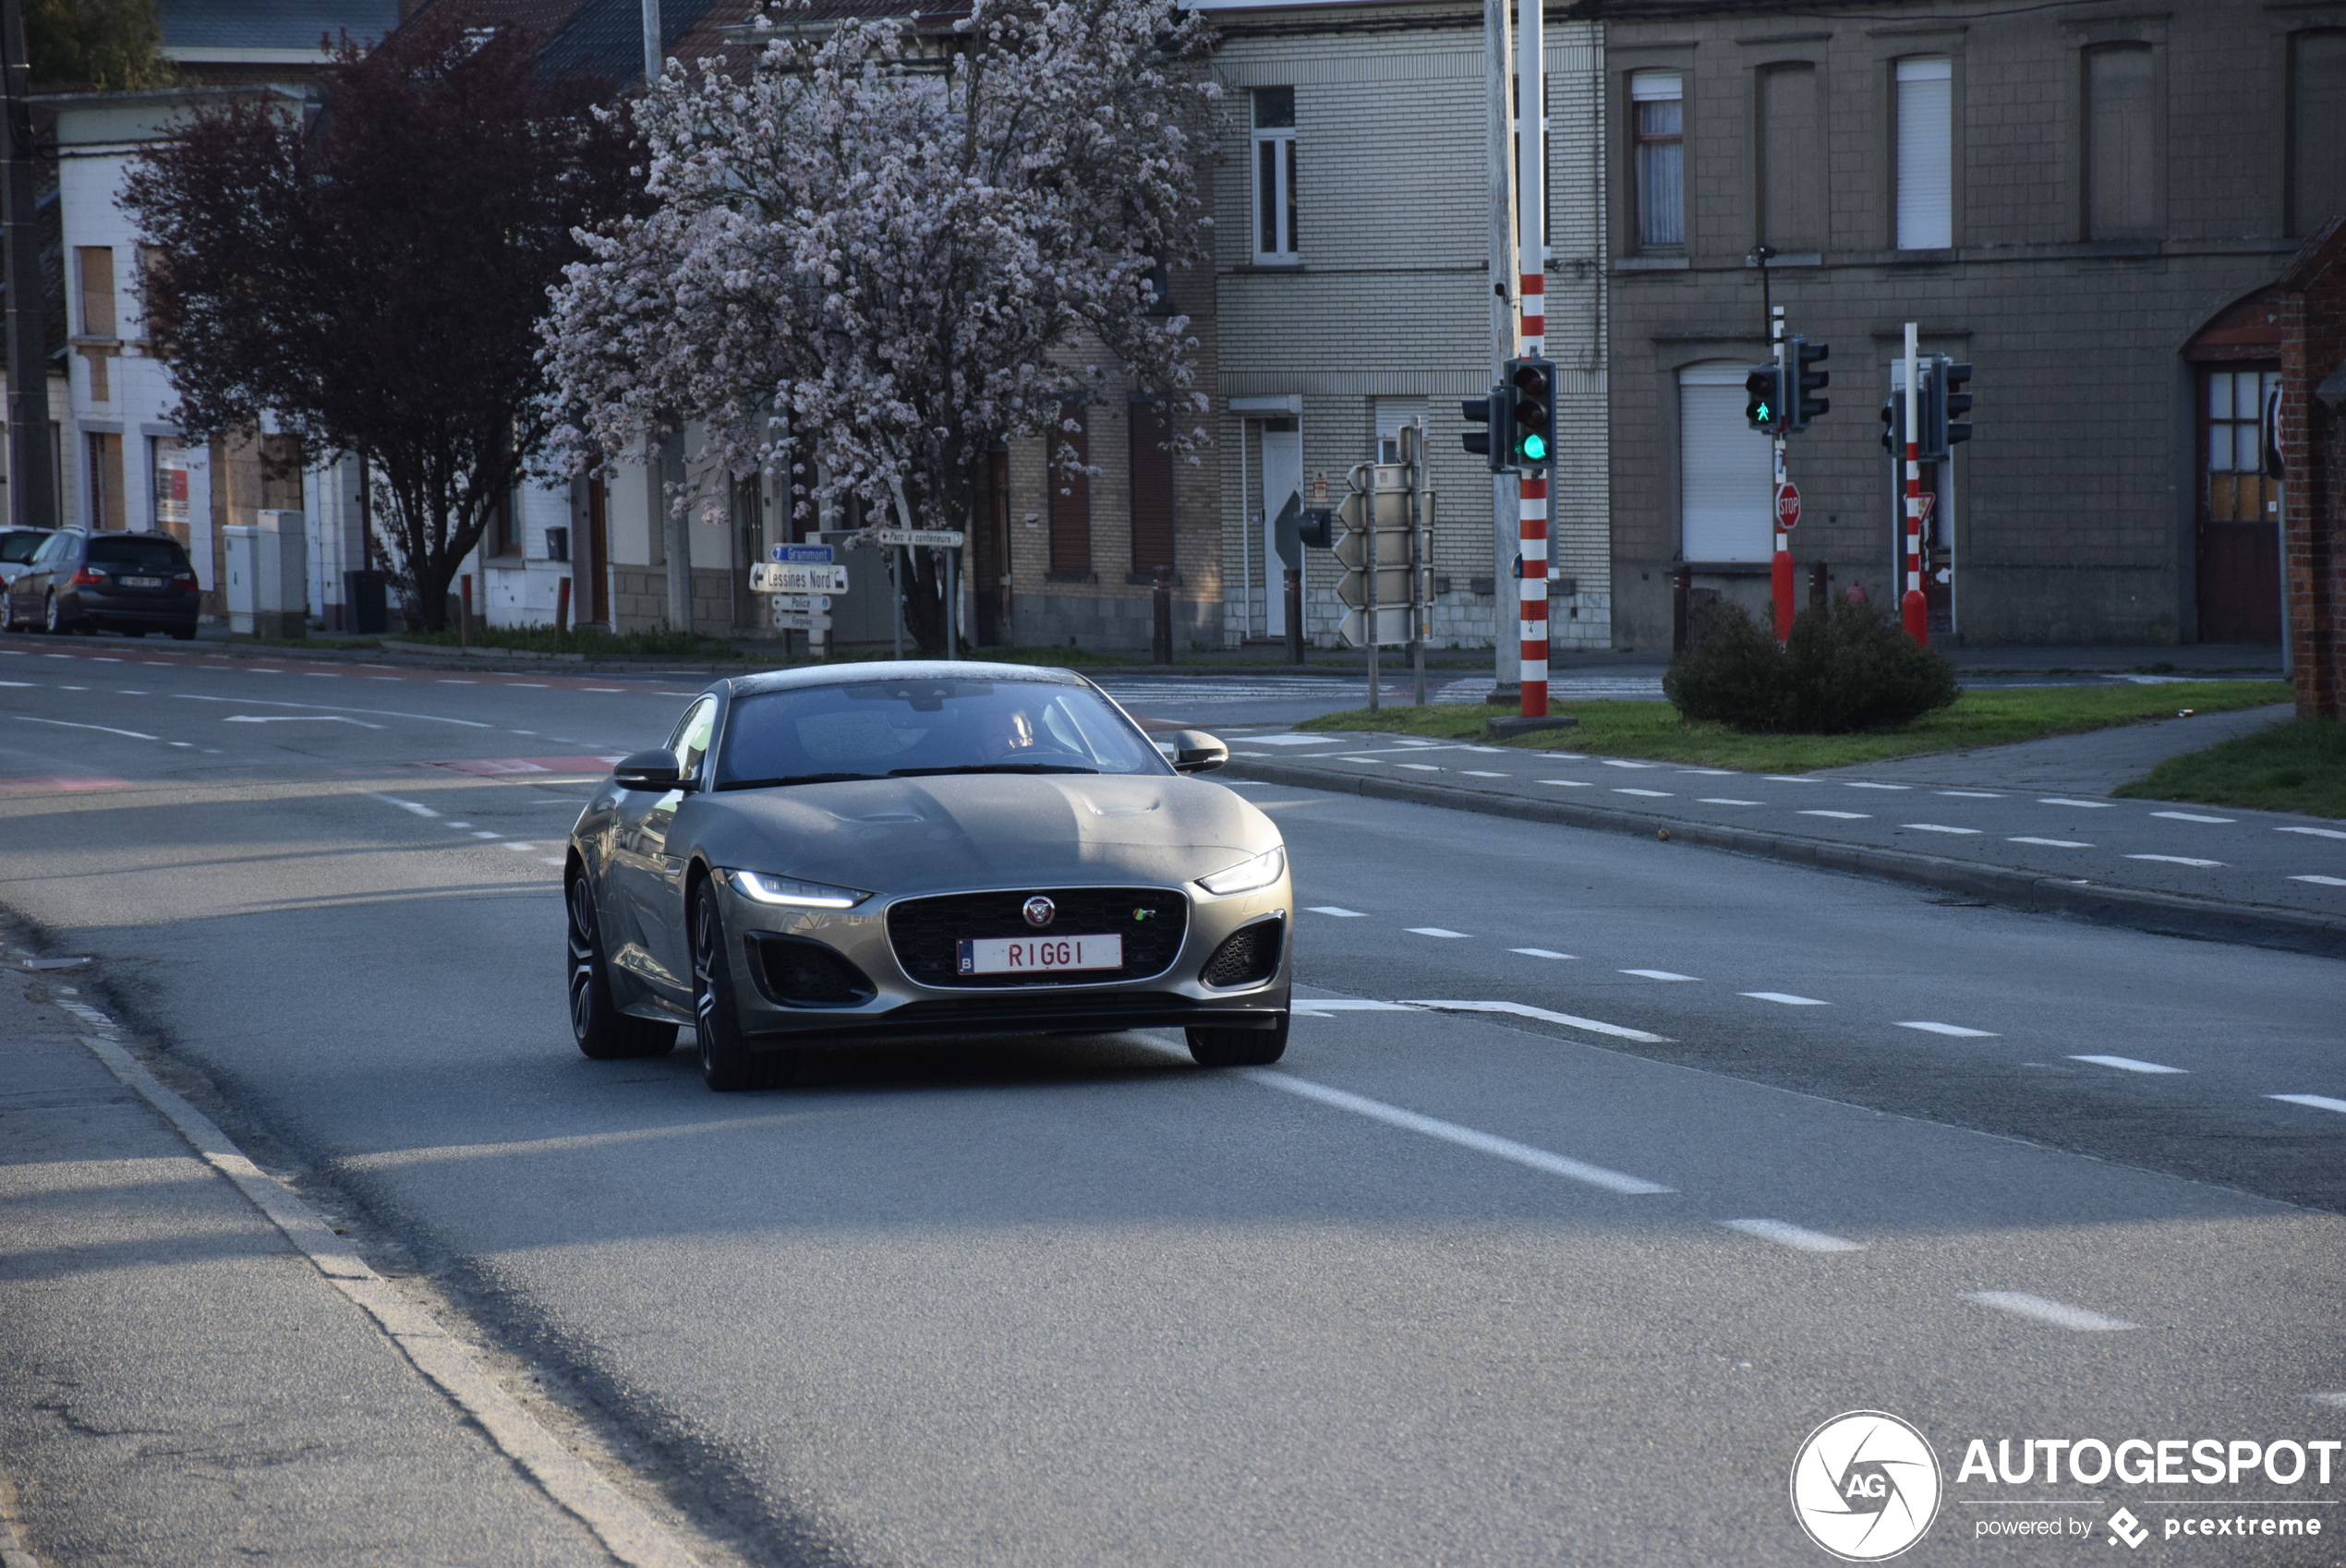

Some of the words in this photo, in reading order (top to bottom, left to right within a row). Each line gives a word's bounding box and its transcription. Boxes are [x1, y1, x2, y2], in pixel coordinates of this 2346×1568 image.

[1780, 497, 1798, 514] STOP
[889, 532, 903, 541] Parc
[908, 532, 913, 542] à
[915, 534, 951, 543] conteneurs
[776, 548, 780, 560] 7
[787, 548, 828, 560] Grammont
[768, 569, 805, 588] Lessines
[810, 568, 830, 588] Nord
[792, 597, 810, 608] Police
[1009, 941, 1082, 967] RIGGI
[962, 959, 971, 969] B
